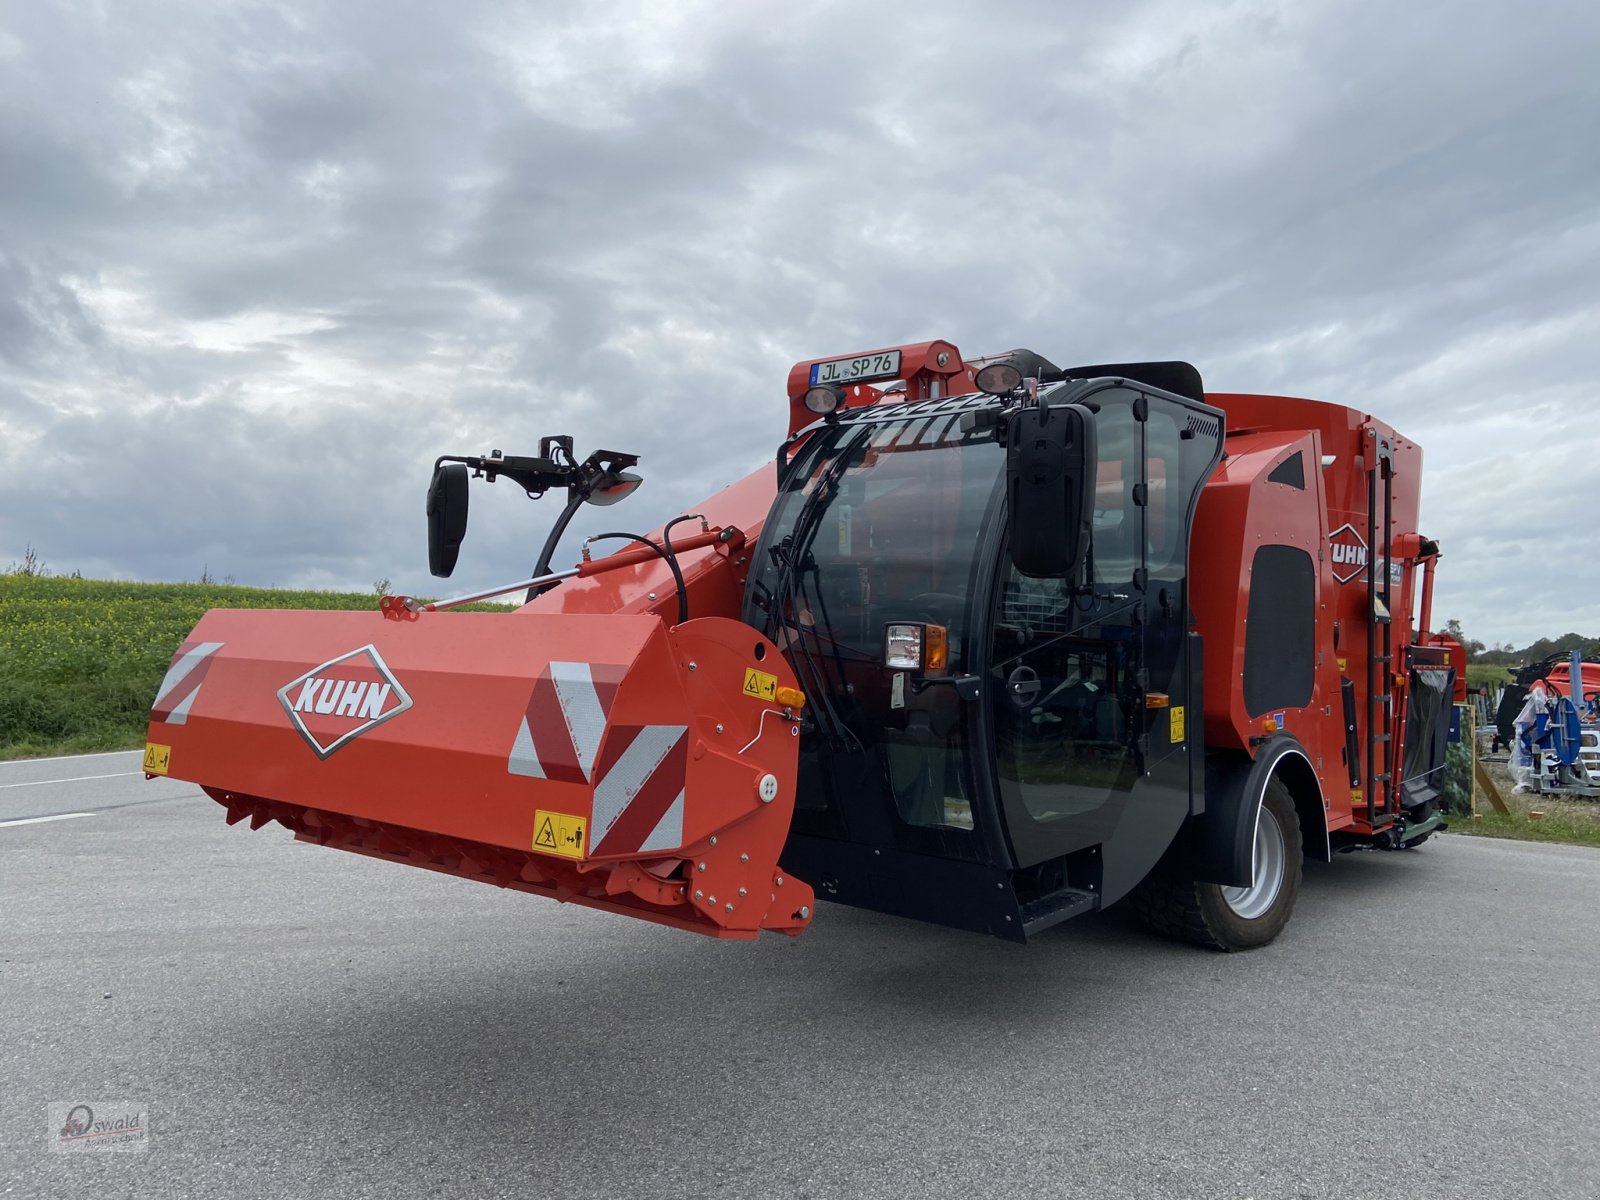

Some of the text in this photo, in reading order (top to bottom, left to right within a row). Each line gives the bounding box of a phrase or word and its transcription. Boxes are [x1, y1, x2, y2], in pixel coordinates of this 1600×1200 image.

[822, 364, 841, 380] JL
[850, 359, 870, 377] SP
[874, 355, 891, 373] 76
[1329, 543, 1366, 566] UHN
[293, 678, 391, 720] KUHN
